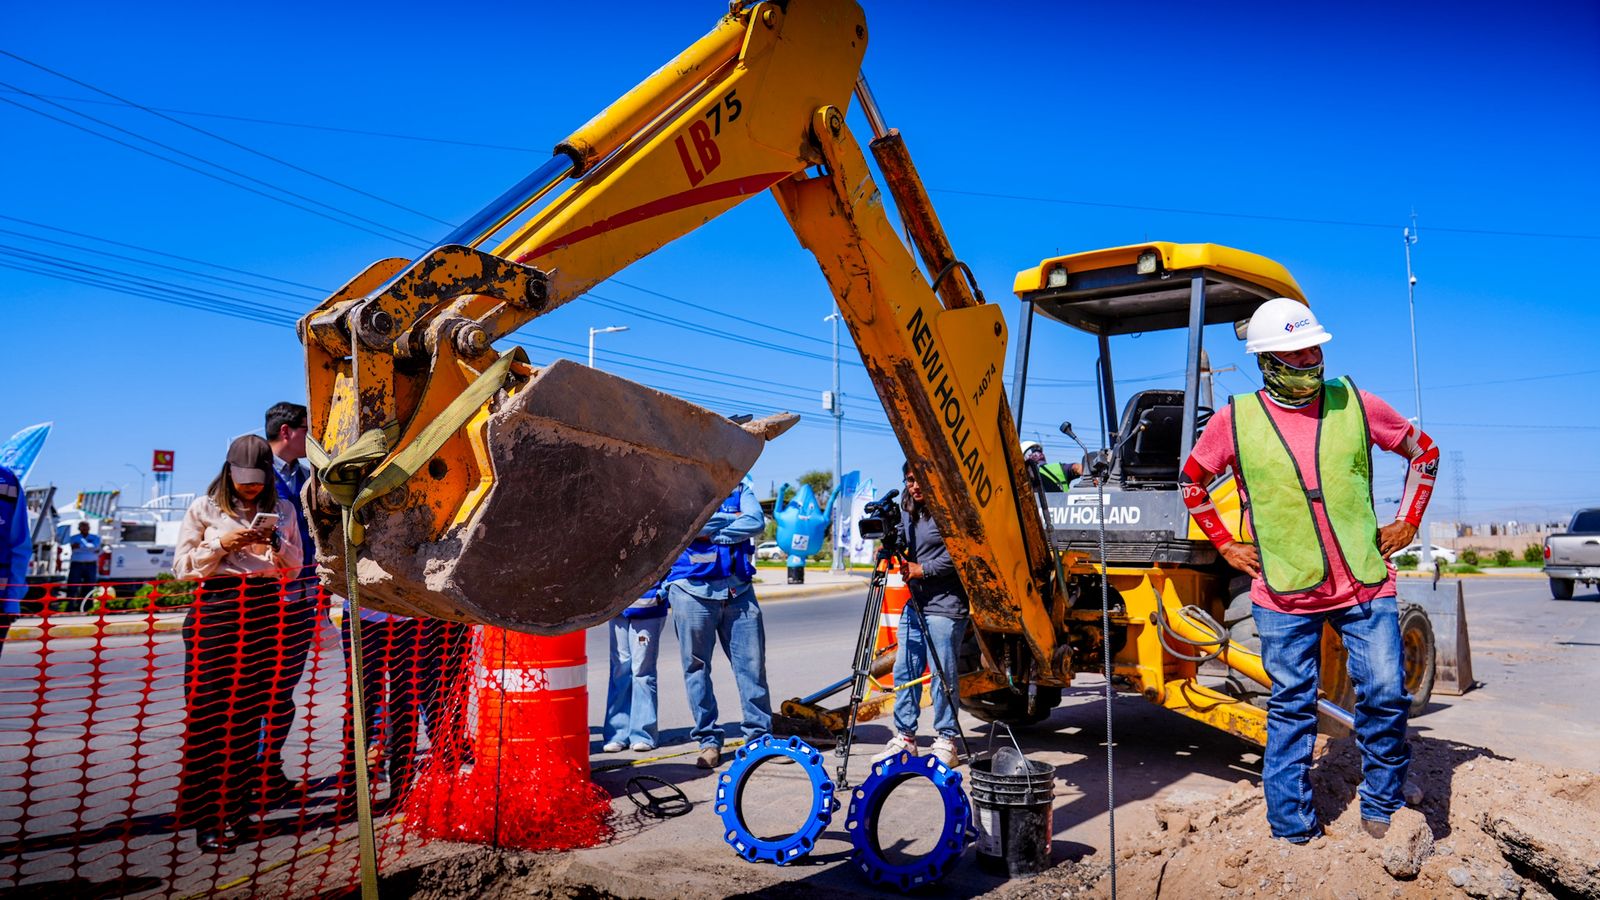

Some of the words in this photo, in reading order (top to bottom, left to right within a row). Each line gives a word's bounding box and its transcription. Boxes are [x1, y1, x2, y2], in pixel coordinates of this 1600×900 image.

[1294, 318, 1310, 328] GCC
[972, 362, 997, 407] 74074
[906, 307, 944, 384] NEW
[934, 374, 993, 508] HOLLAND
